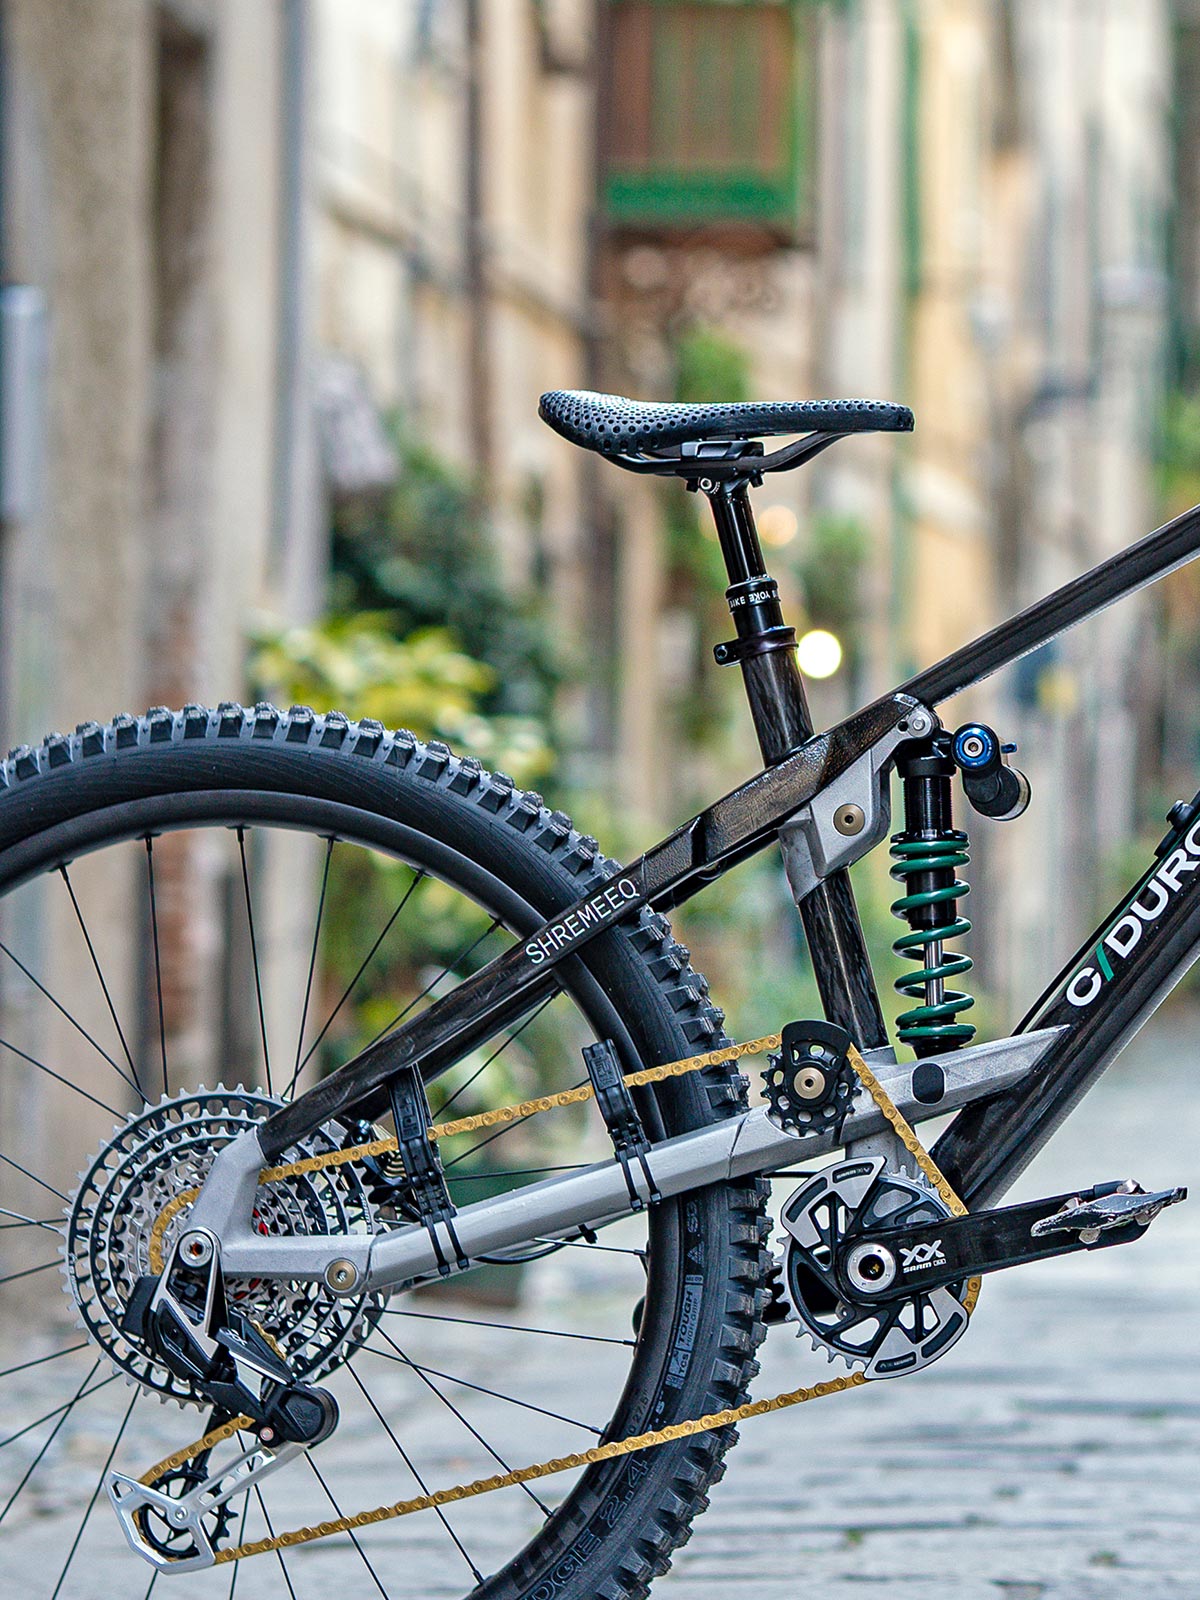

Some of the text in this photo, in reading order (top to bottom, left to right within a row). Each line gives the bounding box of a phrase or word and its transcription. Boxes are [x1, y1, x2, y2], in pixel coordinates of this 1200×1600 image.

[525, 878, 640, 965] SHREMEEQ
[899, 1239, 945, 1267] XX
[903, 1261, 932, 1274] SRAM
[679, 1290, 694, 1345] TOUGH
[678, 1353, 690, 1375] TCS
